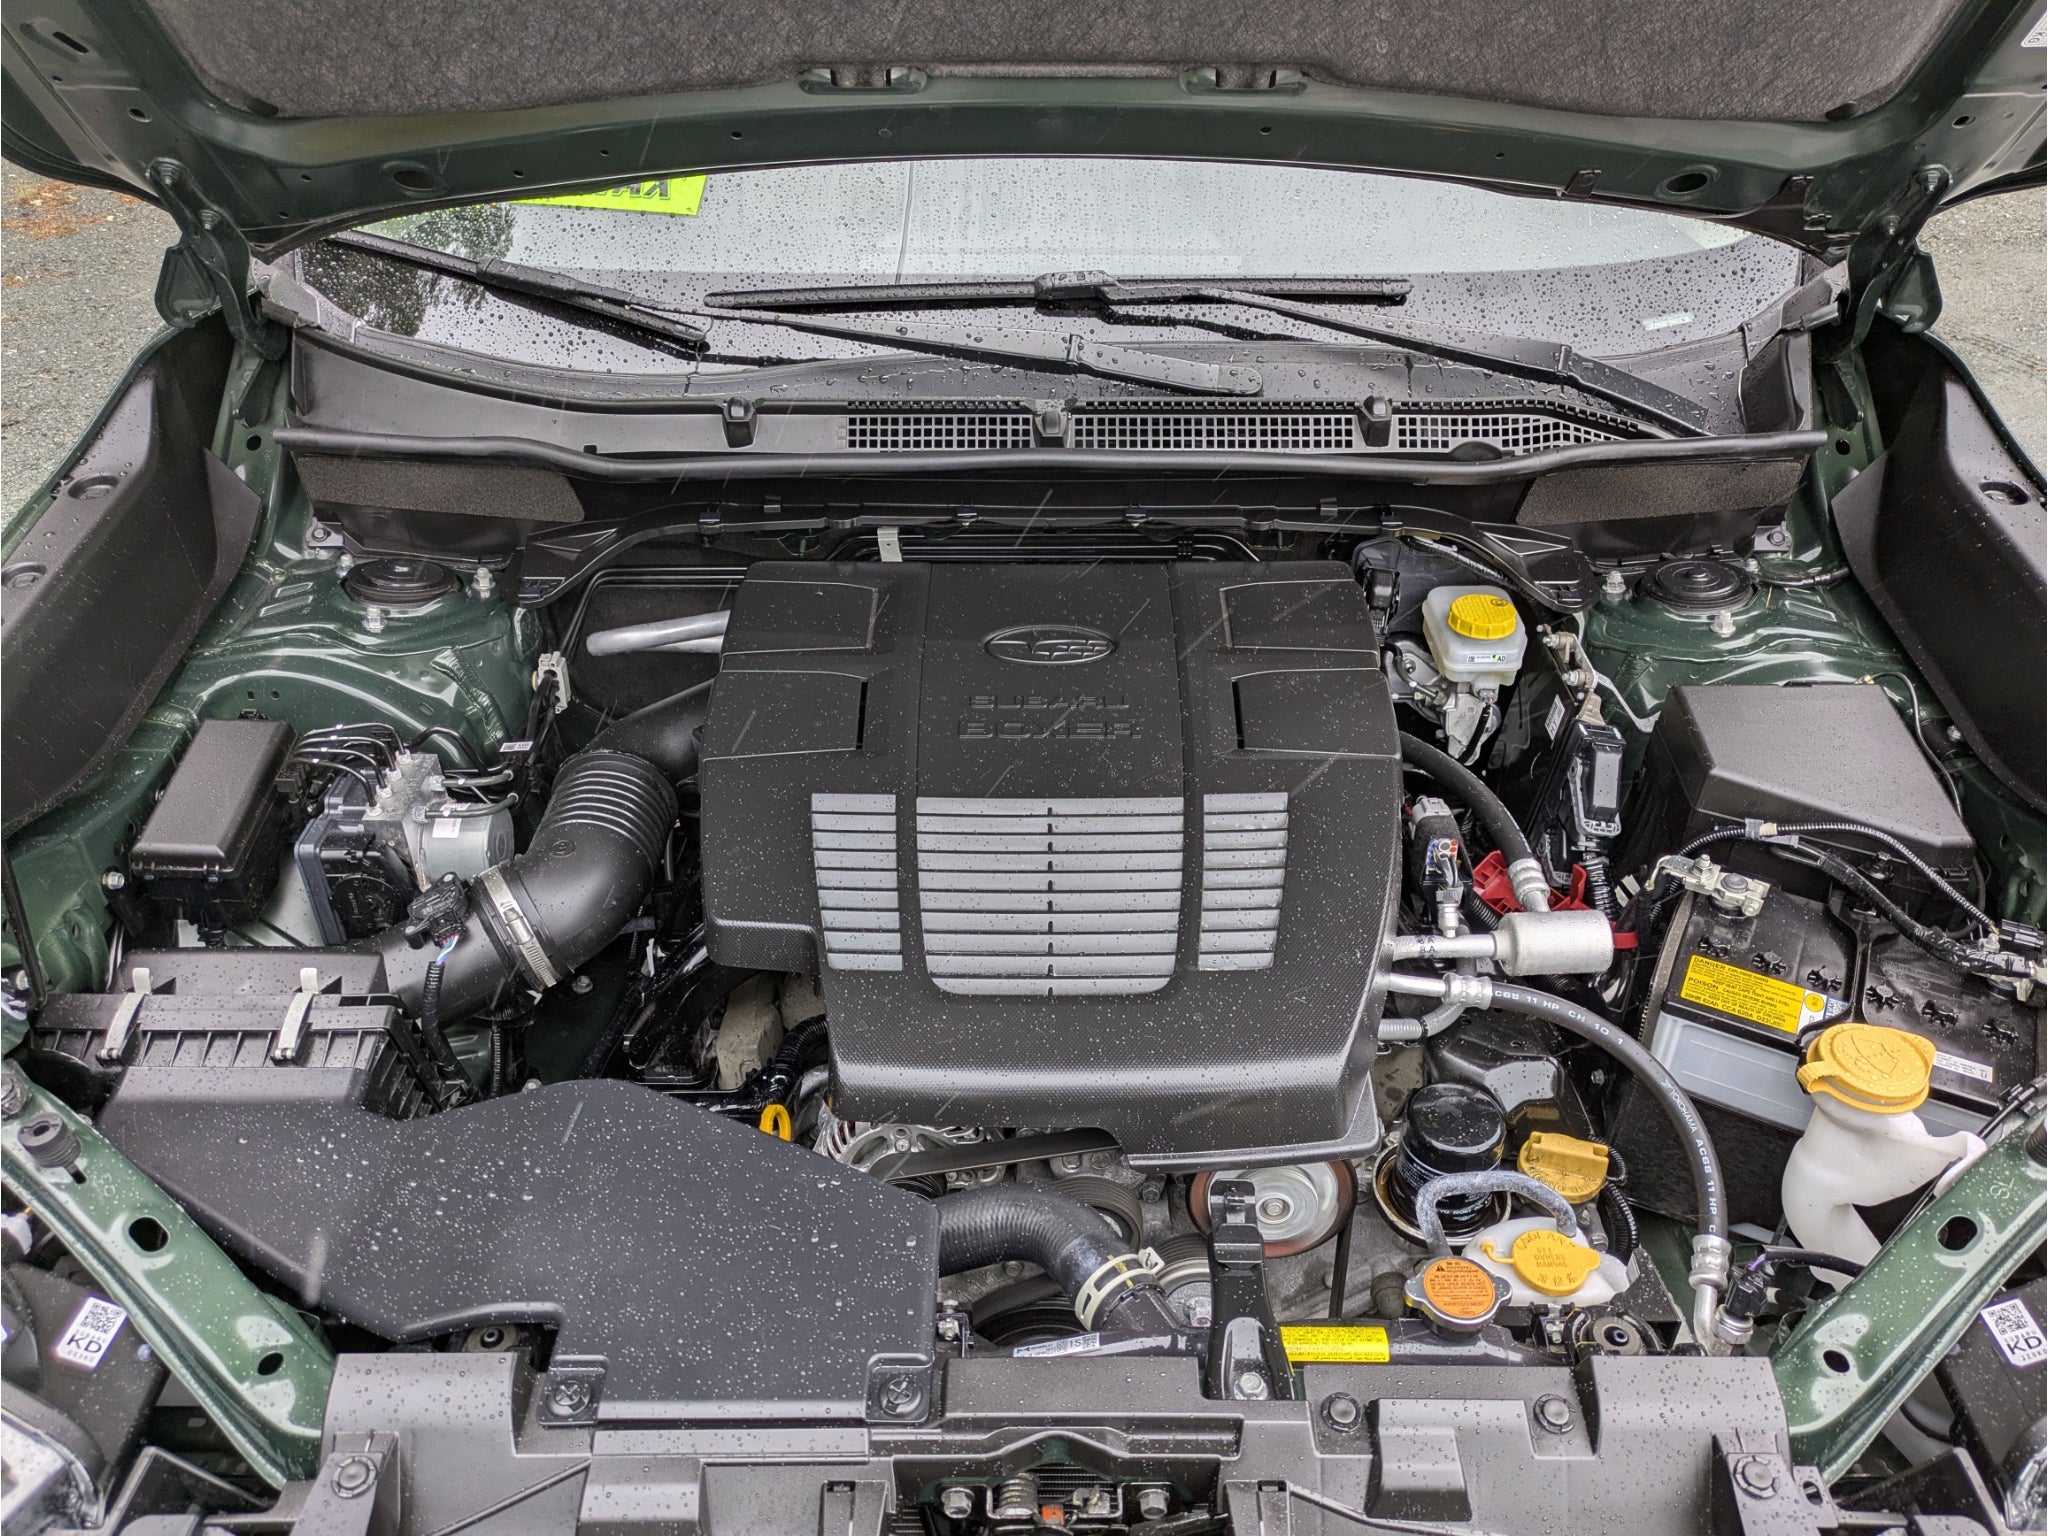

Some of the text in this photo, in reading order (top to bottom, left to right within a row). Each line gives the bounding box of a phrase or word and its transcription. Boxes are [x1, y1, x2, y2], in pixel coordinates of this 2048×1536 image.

[968, 695, 1130, 709] SUBARU
[957, 721, 1142, 739] BOXER
[1693, 956, 1725, 971] DANGER
[1687, 976, 1719, 991] POISON
[1543, 1000, 1560, 1011] HP
[1721, 1003, 1736, 1013] CCA
[1736, 1008, 1754, 1018] 620A
[1670, 1089, 1698, 1133] YOKOHAMA
[1695, 1139, 1713, 1174] ACGB
[1709, 1197, 1717, 1215] HP
[66, 1334, 102, 1353] KD
[2007, 1336, 2042, 1355] KD
